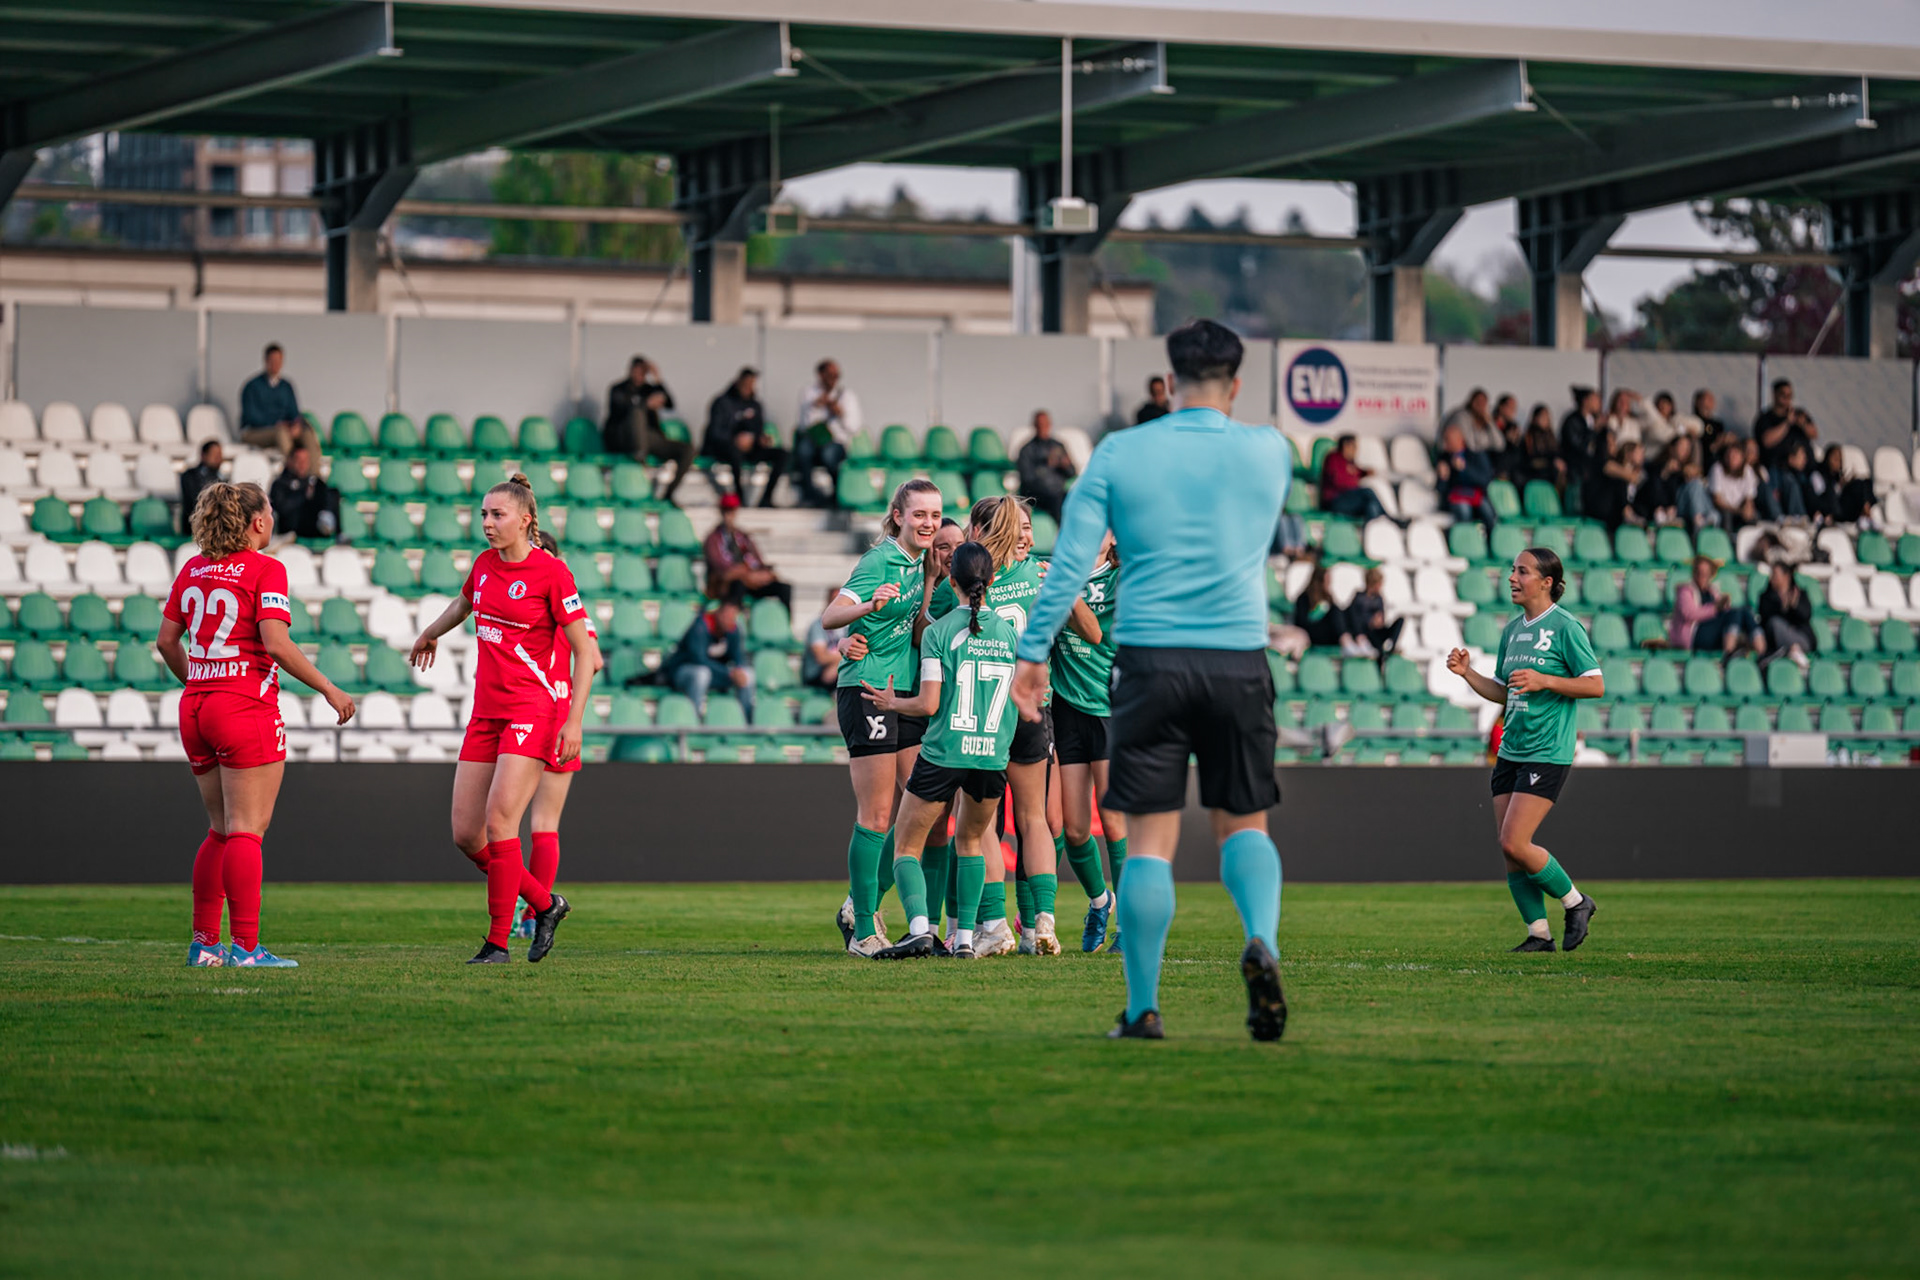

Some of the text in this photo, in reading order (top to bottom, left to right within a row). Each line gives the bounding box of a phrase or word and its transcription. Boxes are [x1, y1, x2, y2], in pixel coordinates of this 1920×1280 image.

[1292, 365, 1344, 403] EVA
[225, 563, 245, 573] AG
[991, 587, 1038, 603] Populaires
[181, 586, 240, 659] 22
[967, 646, 1013, 660] Populaires
[187, 661, 249, 680] URKHART
[950, 660, 1015, 733] 17
[961, 736, 996, 757] GUEDE
